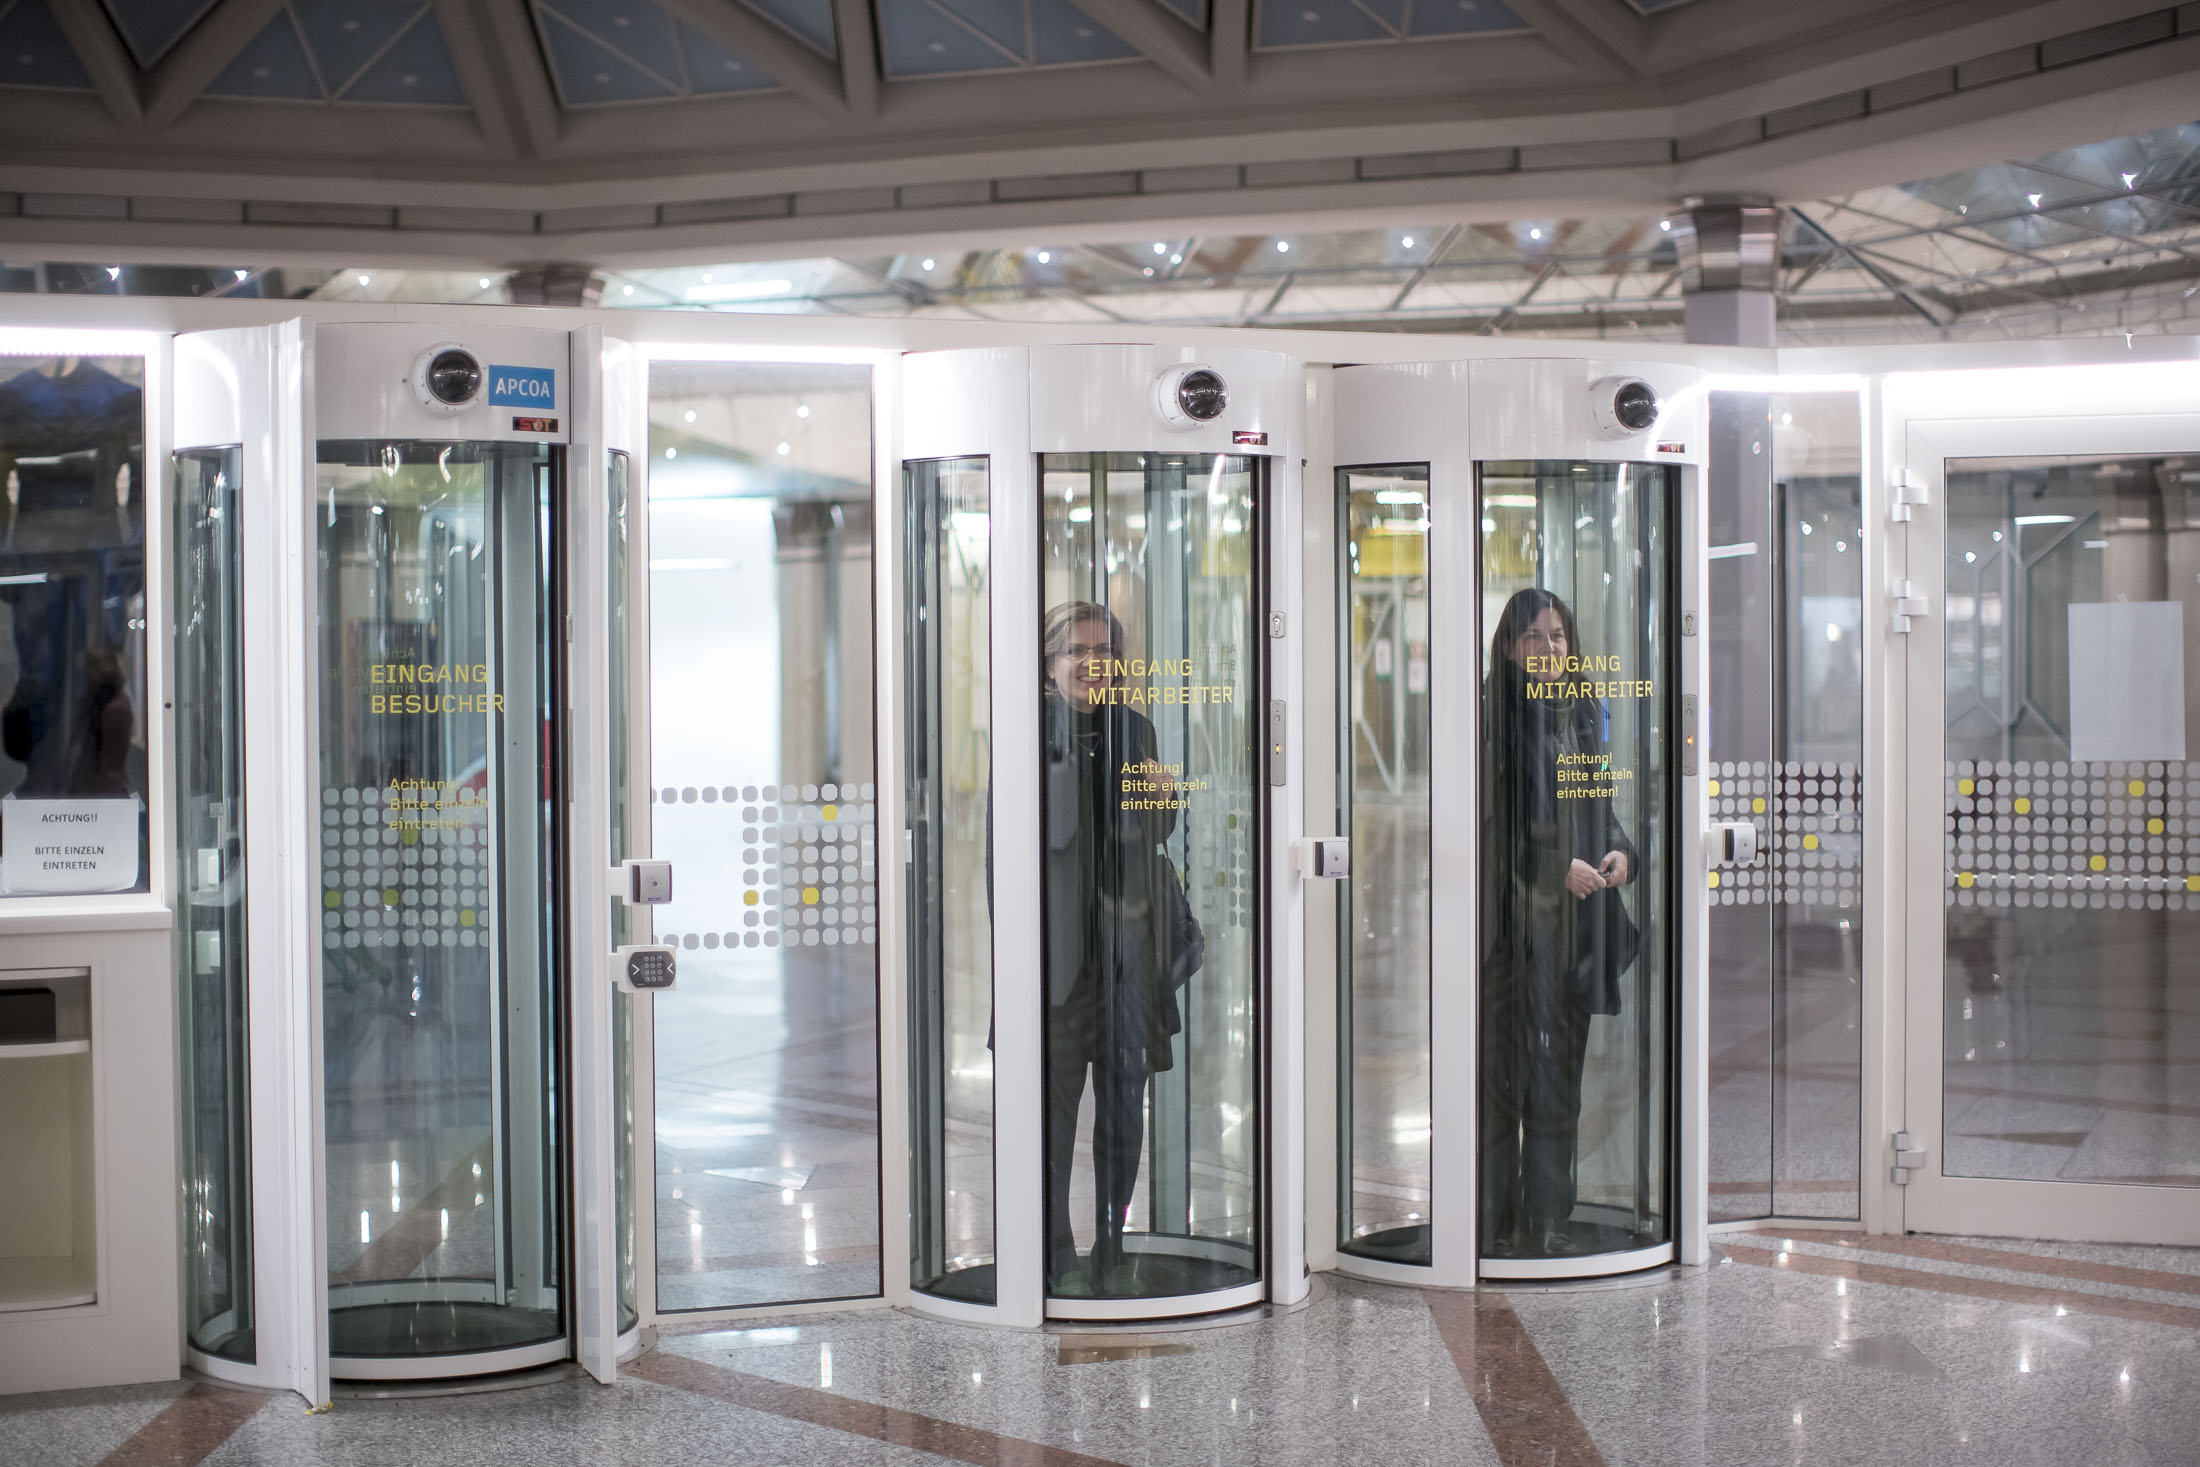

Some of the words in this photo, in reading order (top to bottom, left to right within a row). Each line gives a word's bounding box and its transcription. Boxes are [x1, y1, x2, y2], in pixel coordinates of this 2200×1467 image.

[495, 377, 551, 398] APCOA
[1088, 659, 1193, 677] EINGANG
[1526, 655, 1621, 673] EINGANG
[370, 664, 488, 684] EINGANG
[1088, 686, 1233, 705] MITARBEITER
[1526, 680, 1654, 699] MITARBEITER
[370, 694, 505, 714] BESUCHER
[1556, 751, 1613, 766] Achtung!
[1120, 761, 1184, 776] Achtung!
[1557, 770, 1589, 782] Bitte
[1592, 768, 1633, 781] einzeln
[389, 777, 460, 793] Achtung
[1121, 779, 1157, 792] Bitte
[1161, 778, 1208, 792] einzeln
[1556, 786, 1619, 799] eintreten!
[390, 797, 430, 811] Bitte
[1120, 797, 1191, 810] eintreten!
[41, 813, 98, 823] ACHTUNG!!
[34, 846, 62, 855] BITTE
[64, 846, 105, 855] EINZELN
[42, 861, 97, 870] EINTRETEN
